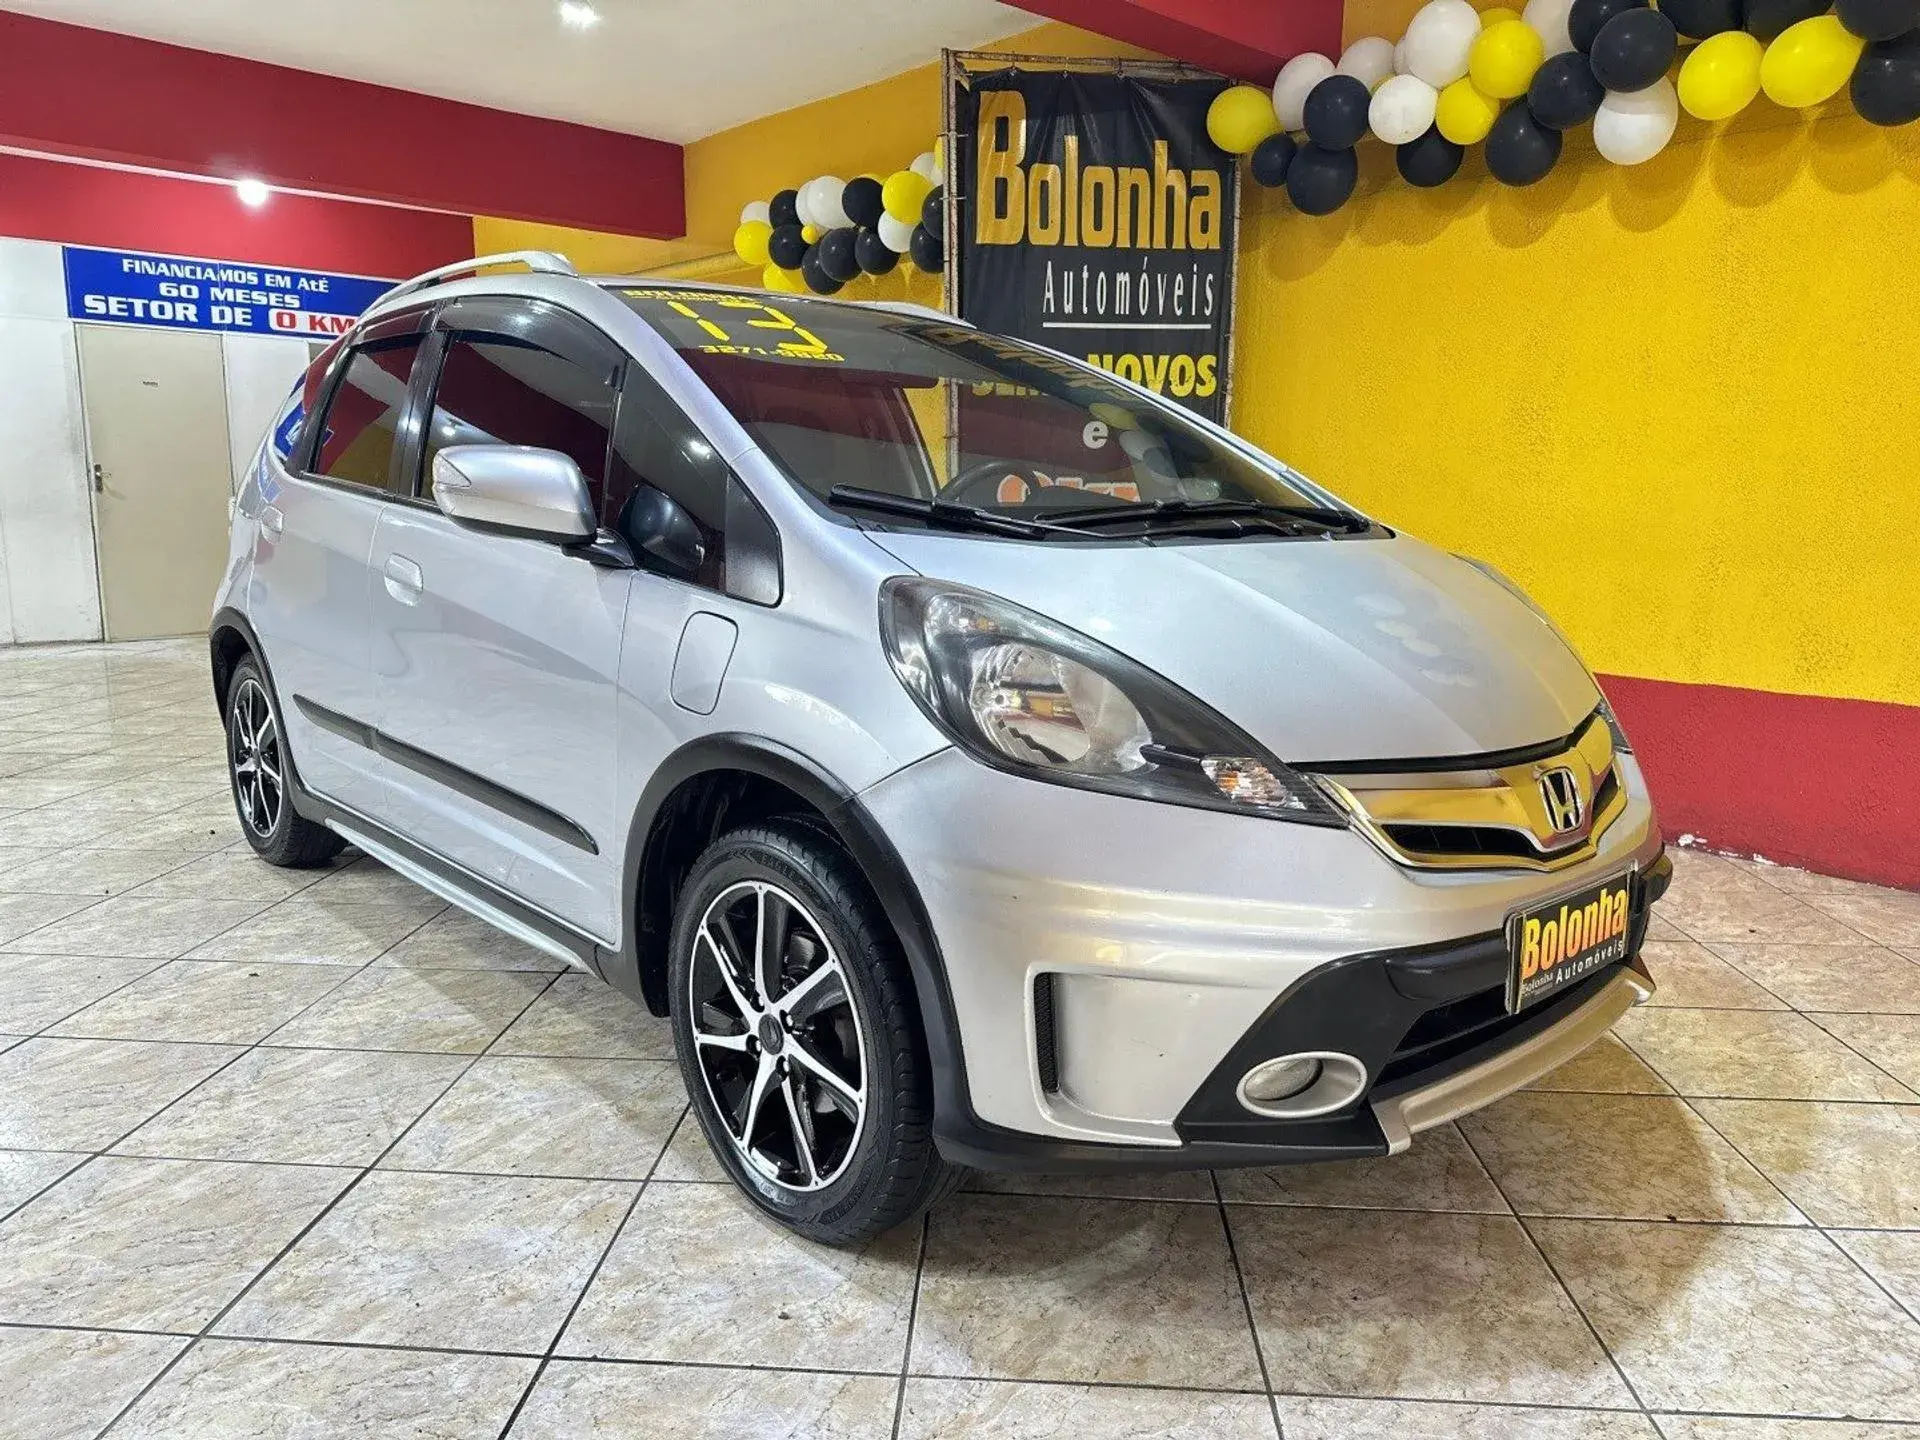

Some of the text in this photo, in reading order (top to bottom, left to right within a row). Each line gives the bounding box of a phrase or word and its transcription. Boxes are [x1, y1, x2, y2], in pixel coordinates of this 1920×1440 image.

[975, 90, 1222, 250] Bolonha
[122, 258, 258, 285] FINANCIAMOS
[264, 273, 291, 289] EM
[1043, 256, 1214, 317] Automóveis
[84, 294, 198, 322] SETOR
[210, 305, 252, 327] DE
[308, 314, 355, 333] KM
[159, 282, 300, 308] 60 MESES
[1083, 421, 1109, 449] e
[1522, 887, 1627, 981] Bolonha
[1555, 939, 1624, 984] Automóveis
